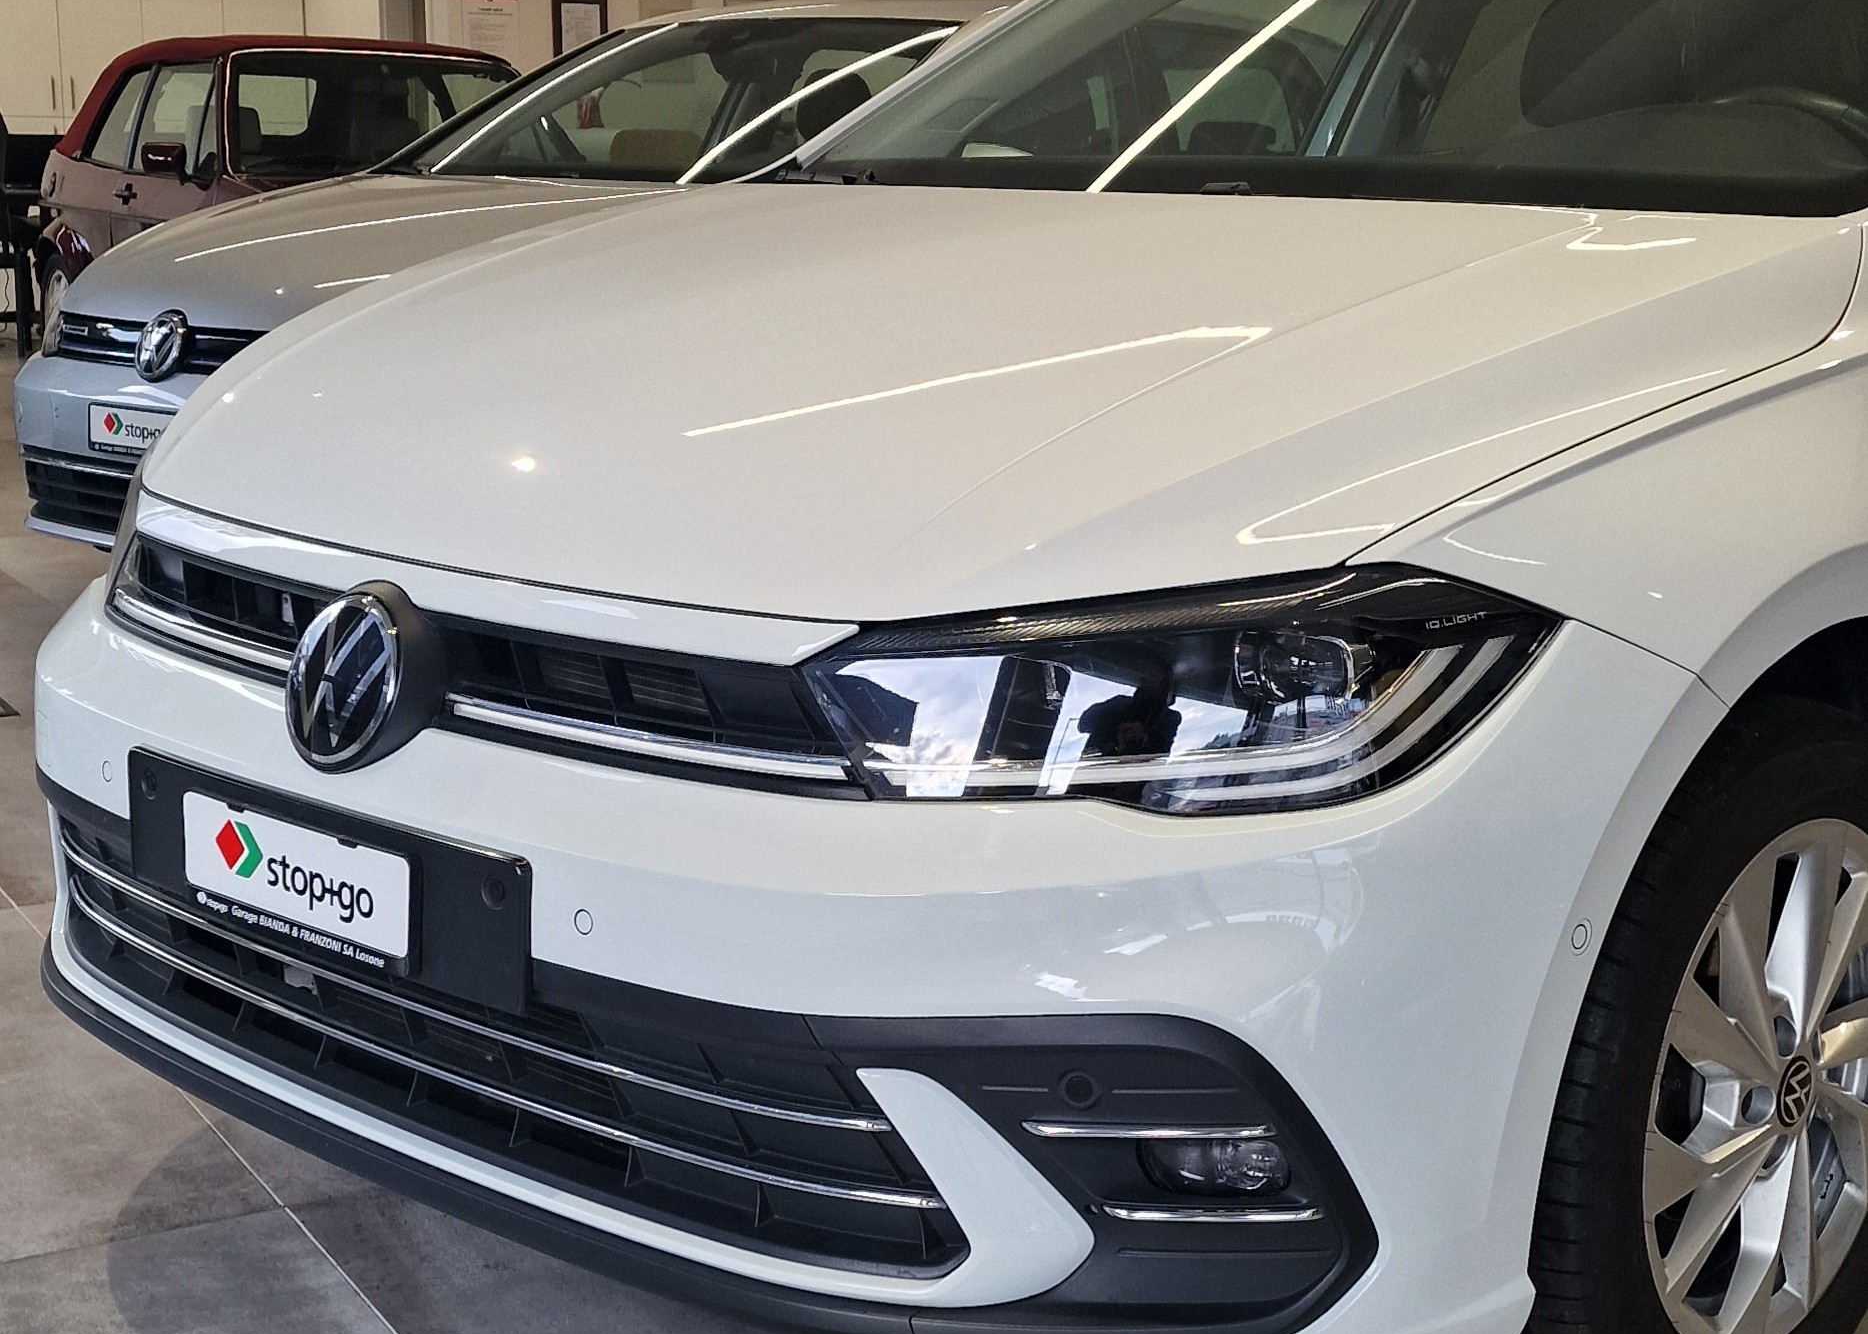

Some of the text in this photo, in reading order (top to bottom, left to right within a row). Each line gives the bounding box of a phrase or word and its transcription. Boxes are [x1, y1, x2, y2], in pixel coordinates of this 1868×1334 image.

[266, 854, 374, 923] stop+go
[231, 905, 258, 924] Garage
[259, 915, 290, 935] BIANDA
[291, 927, 299, 938] &
[299, 928, 342, 953] FRANZONI
[342, 944, 354, 958] SA
[355, 948, 385, 968] Losone
